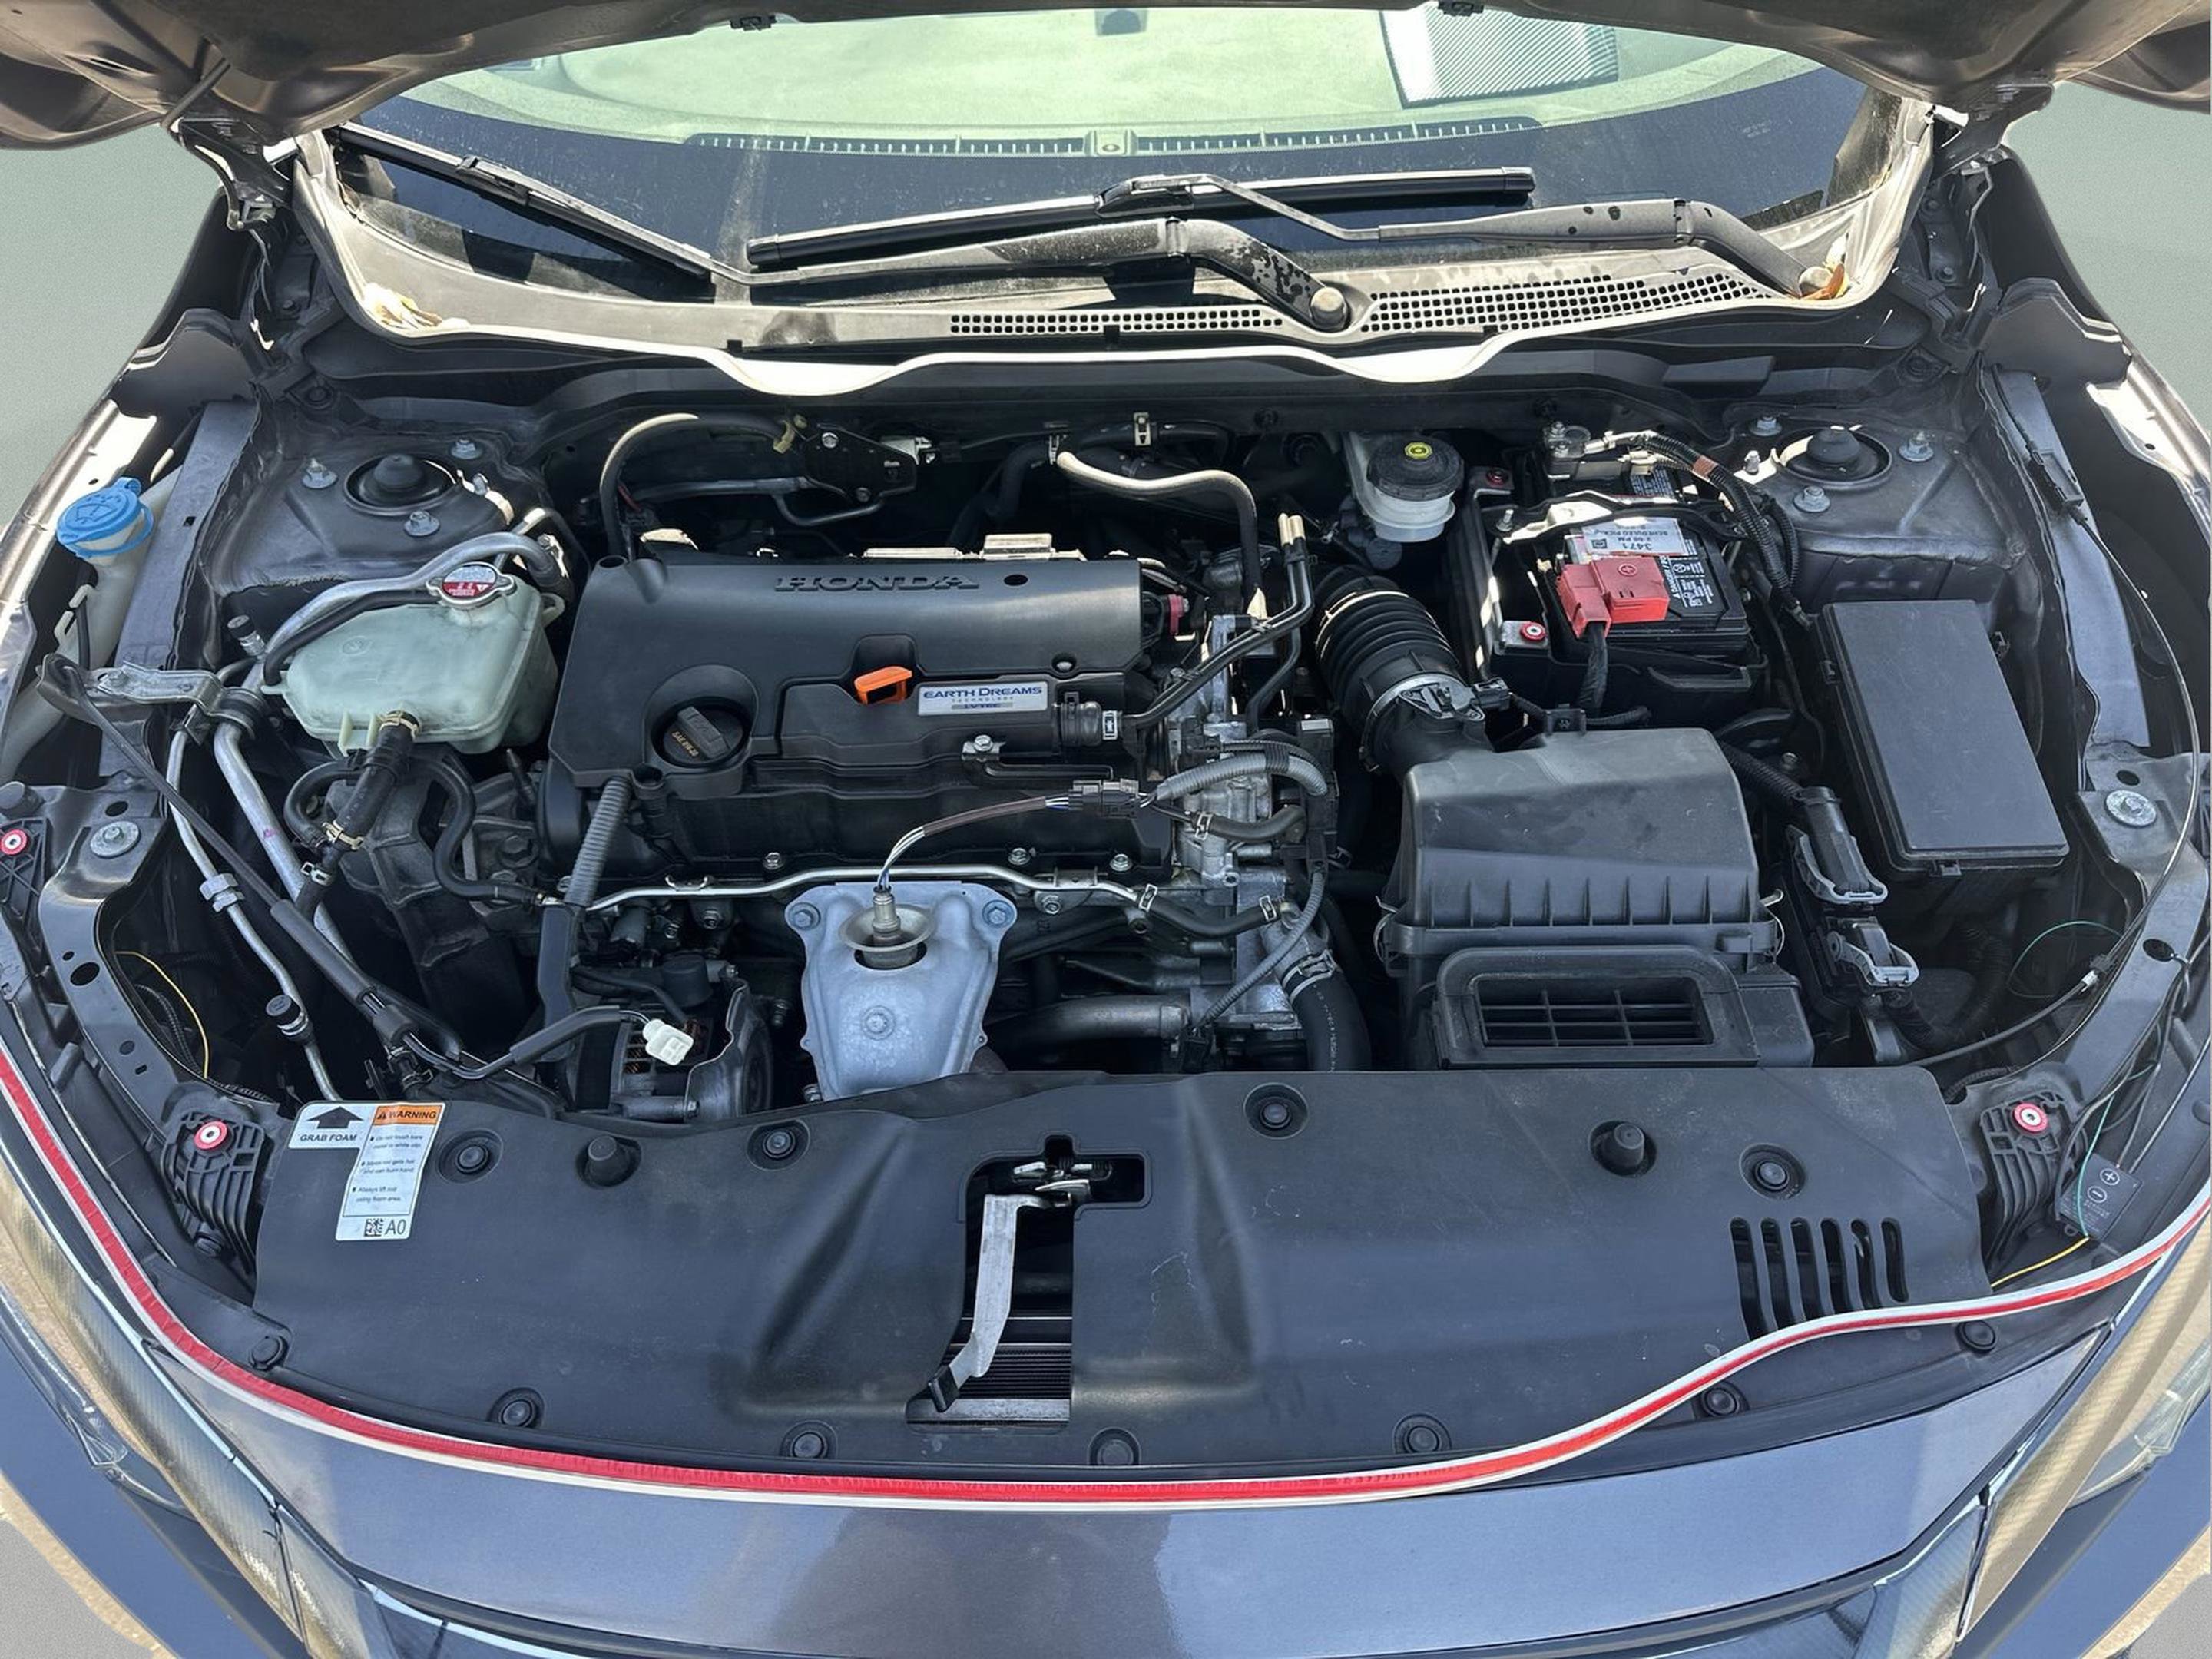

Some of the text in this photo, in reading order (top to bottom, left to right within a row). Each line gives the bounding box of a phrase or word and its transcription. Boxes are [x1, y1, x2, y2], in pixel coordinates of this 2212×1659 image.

[774, 576, 979, 591] HONDA
[1664, 570, 1678, 592] DANGER
[923, 687, 1042, 699] EARTH DREAMS
[389, 1111, 436, 1119] WARNING
[385, 1219, 406, 1235] A0
